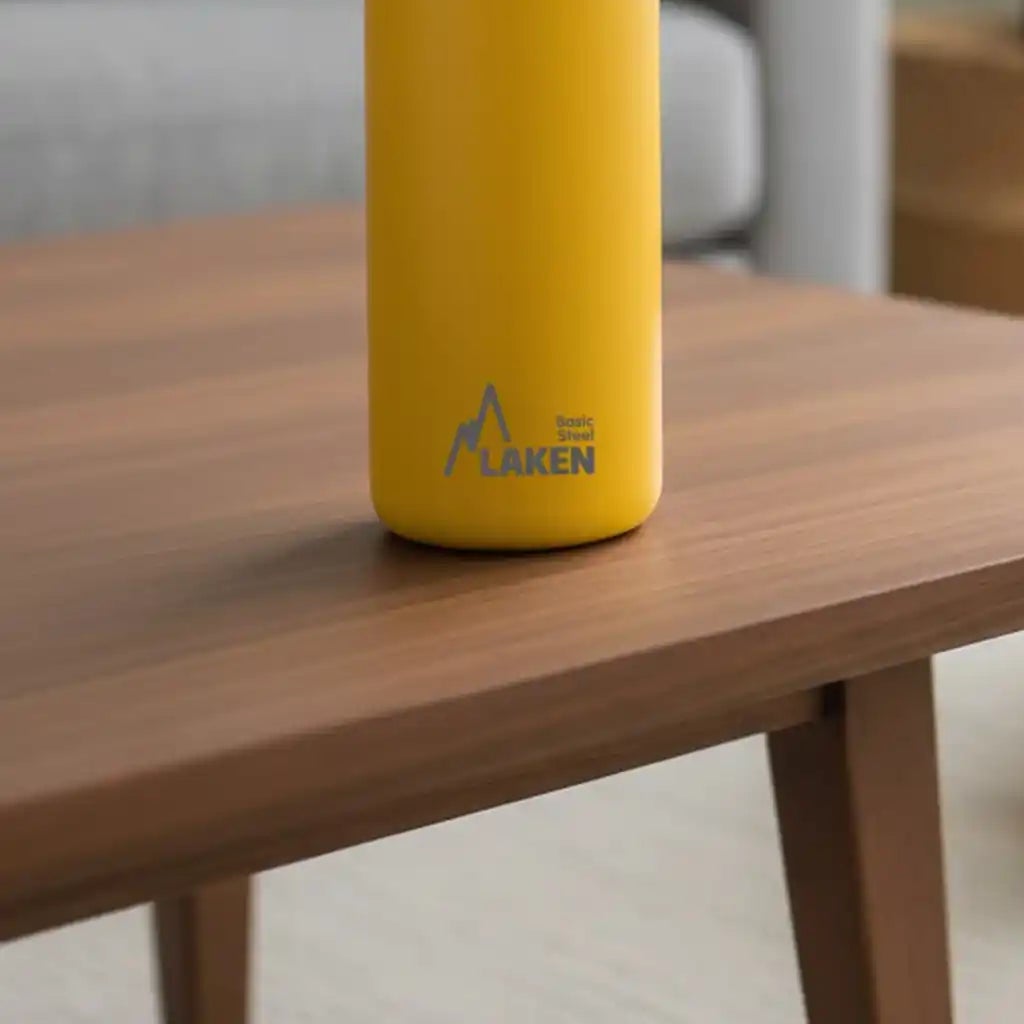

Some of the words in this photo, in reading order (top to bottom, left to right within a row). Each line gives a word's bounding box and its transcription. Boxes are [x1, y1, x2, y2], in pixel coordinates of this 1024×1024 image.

[556, 414, 594, 428] Basic
[557, 429, 595, 442] Steel
[480, 446, 596, 476] LAKEN
